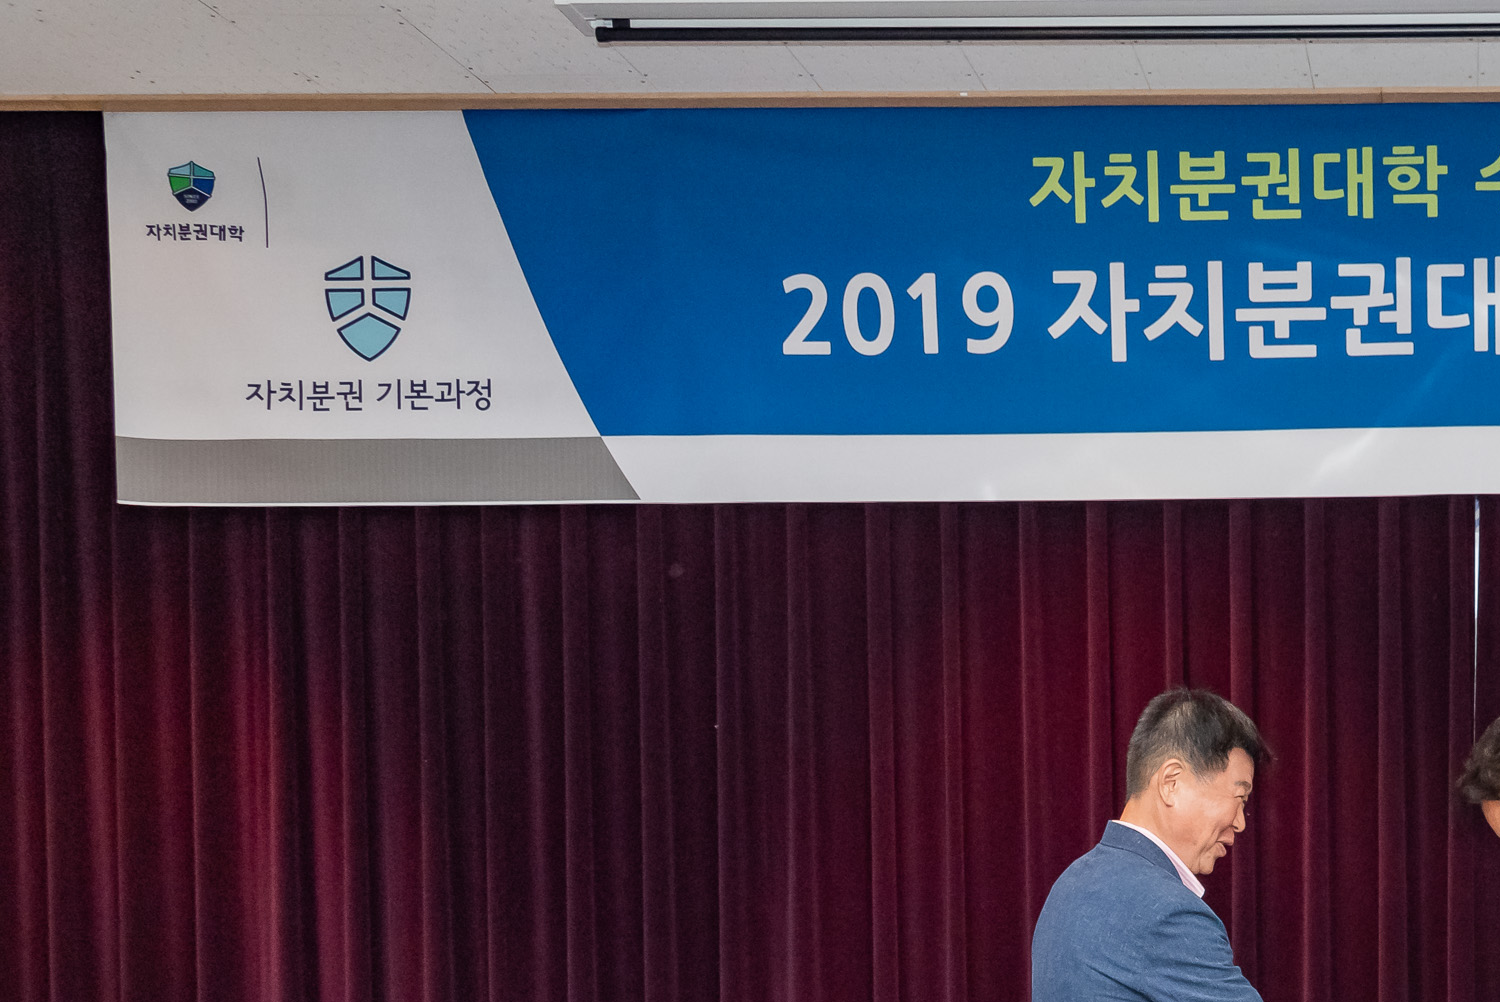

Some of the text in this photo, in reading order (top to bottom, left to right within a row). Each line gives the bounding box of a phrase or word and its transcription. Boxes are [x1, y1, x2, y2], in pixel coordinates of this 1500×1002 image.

[1028, 144, 1448, 223] 자치분권대학
[145, 222, 245, 242] 자치분권대학
[781, 271, 1016, 356] 2019
[245, 377, 493, 412] 자치분권 기본과정
